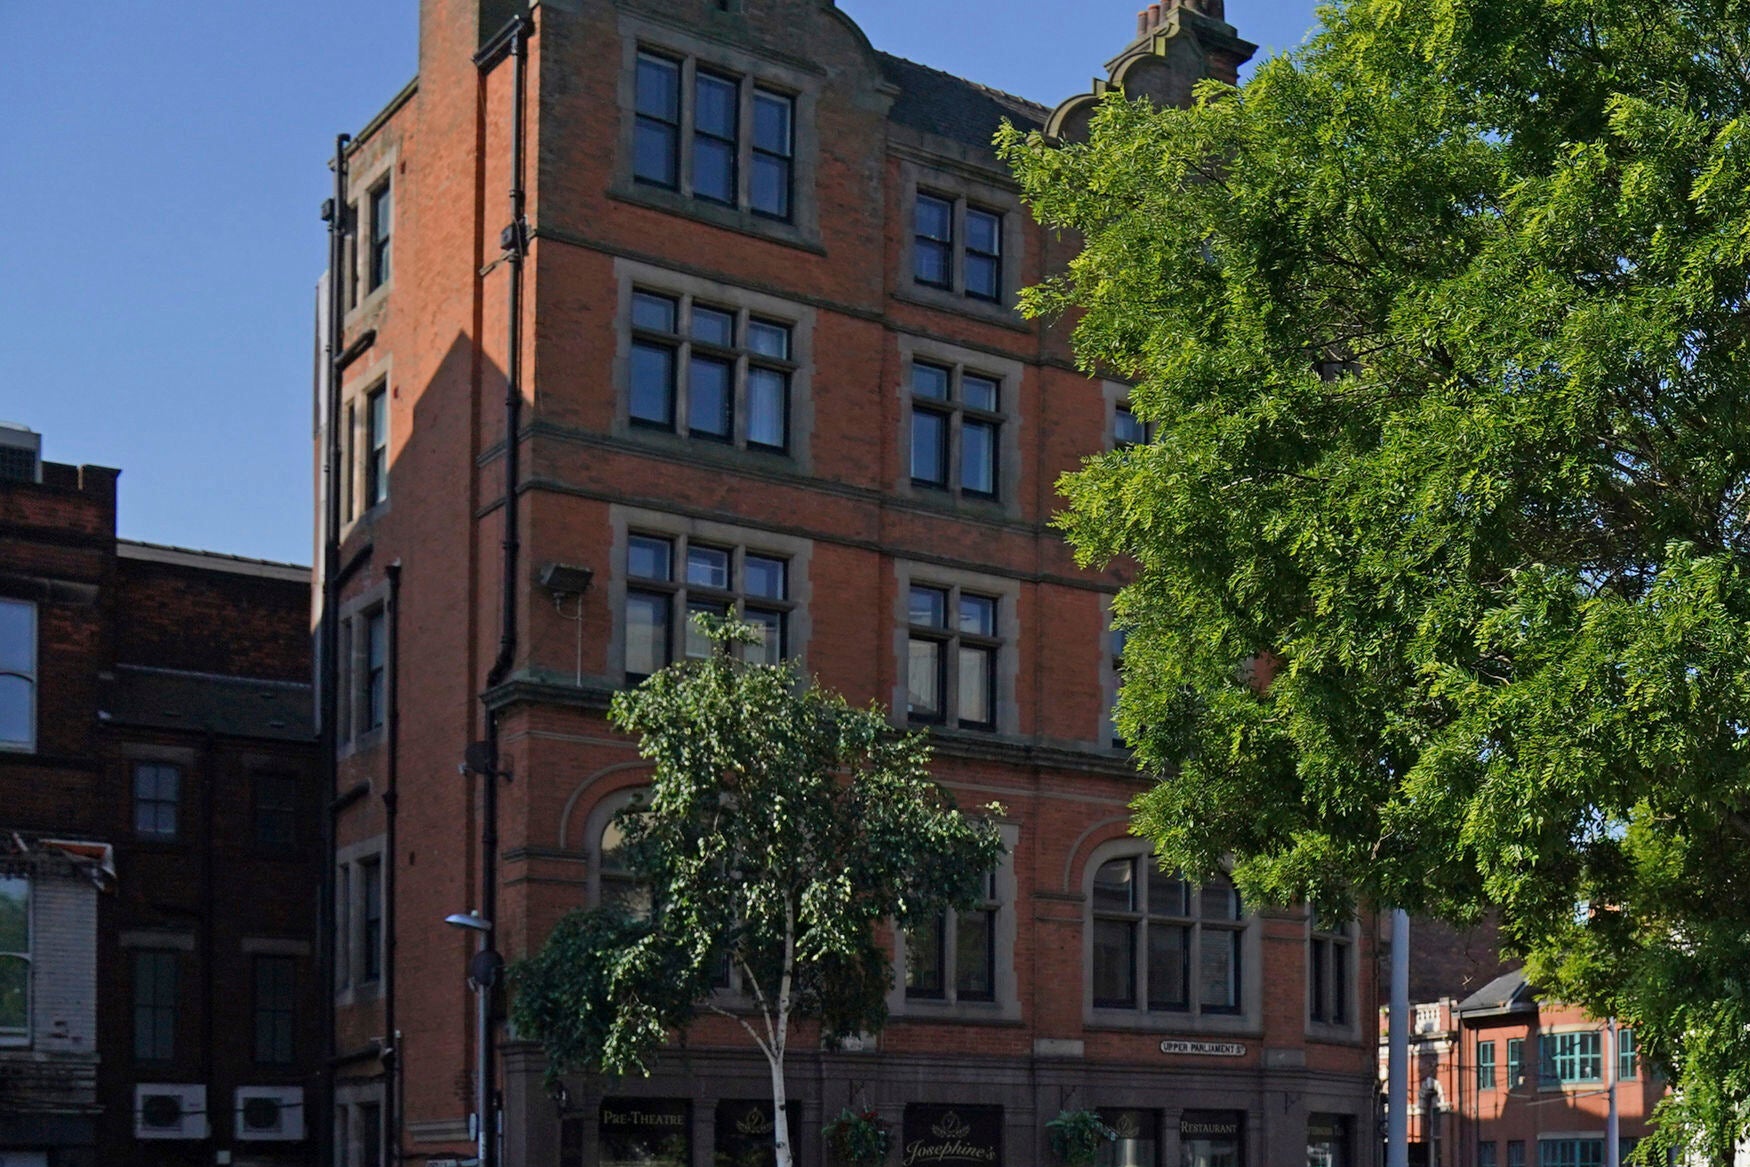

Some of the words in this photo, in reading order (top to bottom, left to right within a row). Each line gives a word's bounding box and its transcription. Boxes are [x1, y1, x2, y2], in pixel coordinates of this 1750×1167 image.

[1163, 1042, 1188, 1051] UPPER
[1191, 1043, 1234, 1053] PARLIAMENT
[1181, 1120, 1238, 1134] RESTAURANT
[903, 1139, 997, 1167] Josephine's
